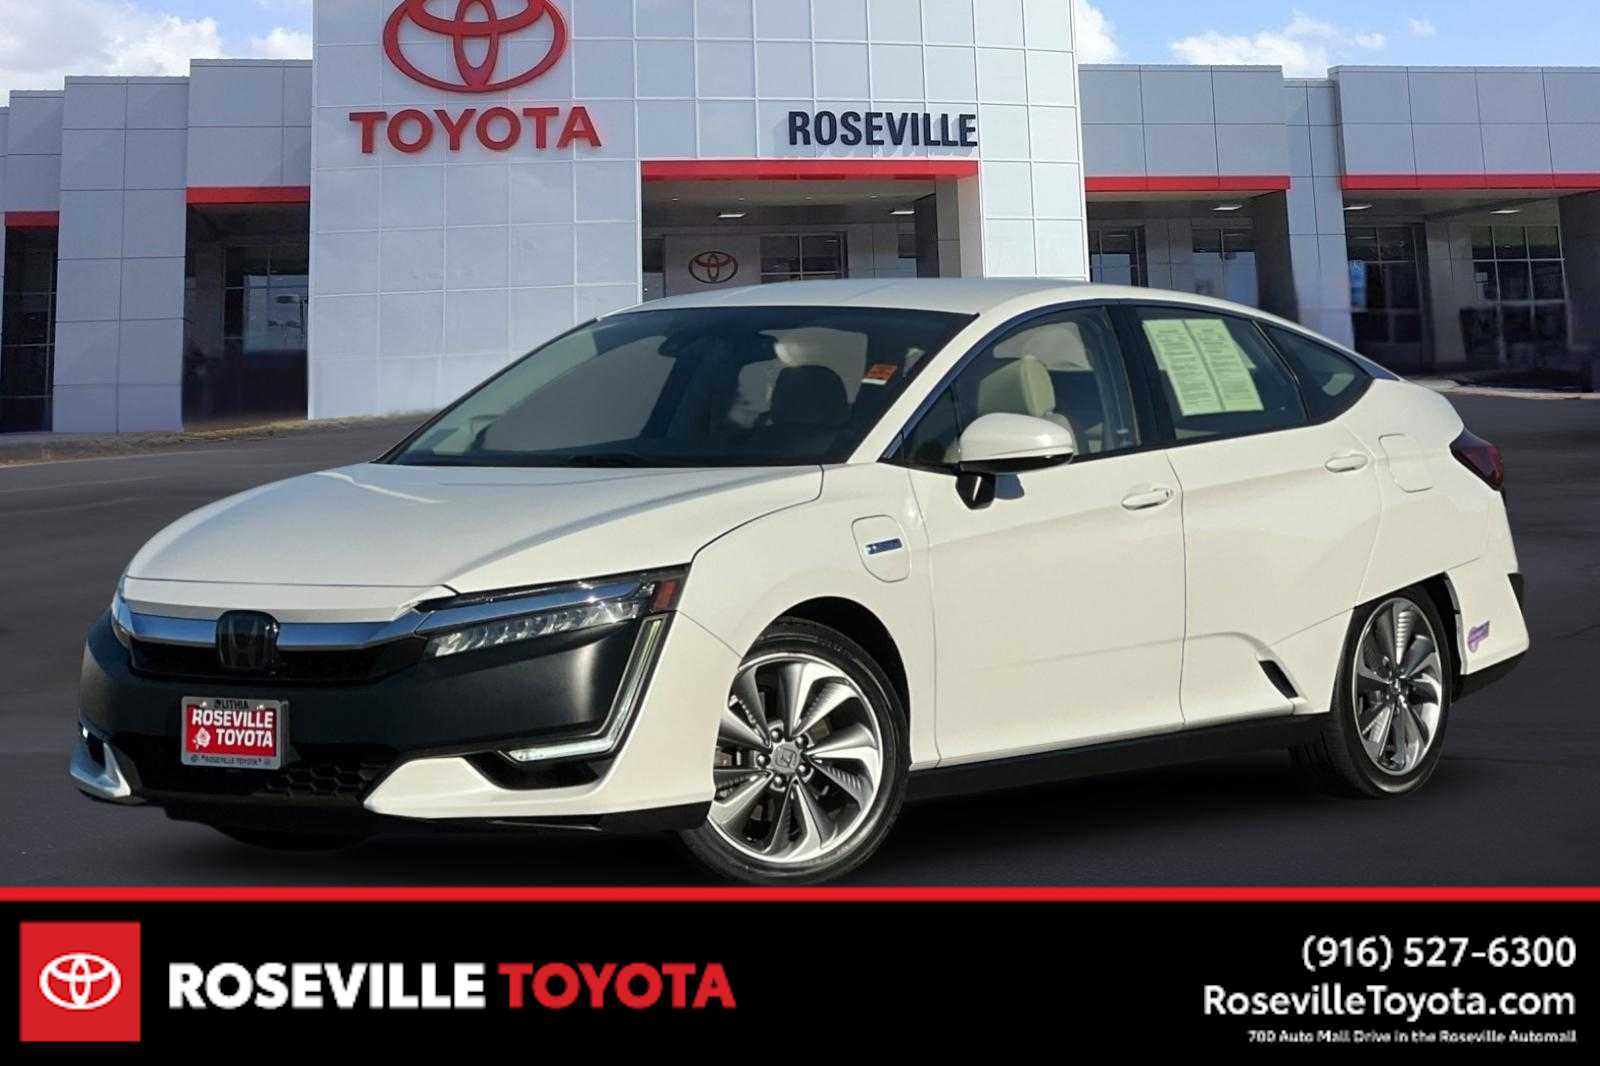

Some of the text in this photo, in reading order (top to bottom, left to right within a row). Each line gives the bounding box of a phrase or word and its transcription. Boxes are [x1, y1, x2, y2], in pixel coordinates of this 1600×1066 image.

[350, 105, 602, 154] TOYOTA
[788, 110, 978, 147] ROSEVILLE
[192, 709, 274, 728] ROSEVILLE
[216, 728, 273, 748] TOYOTA
